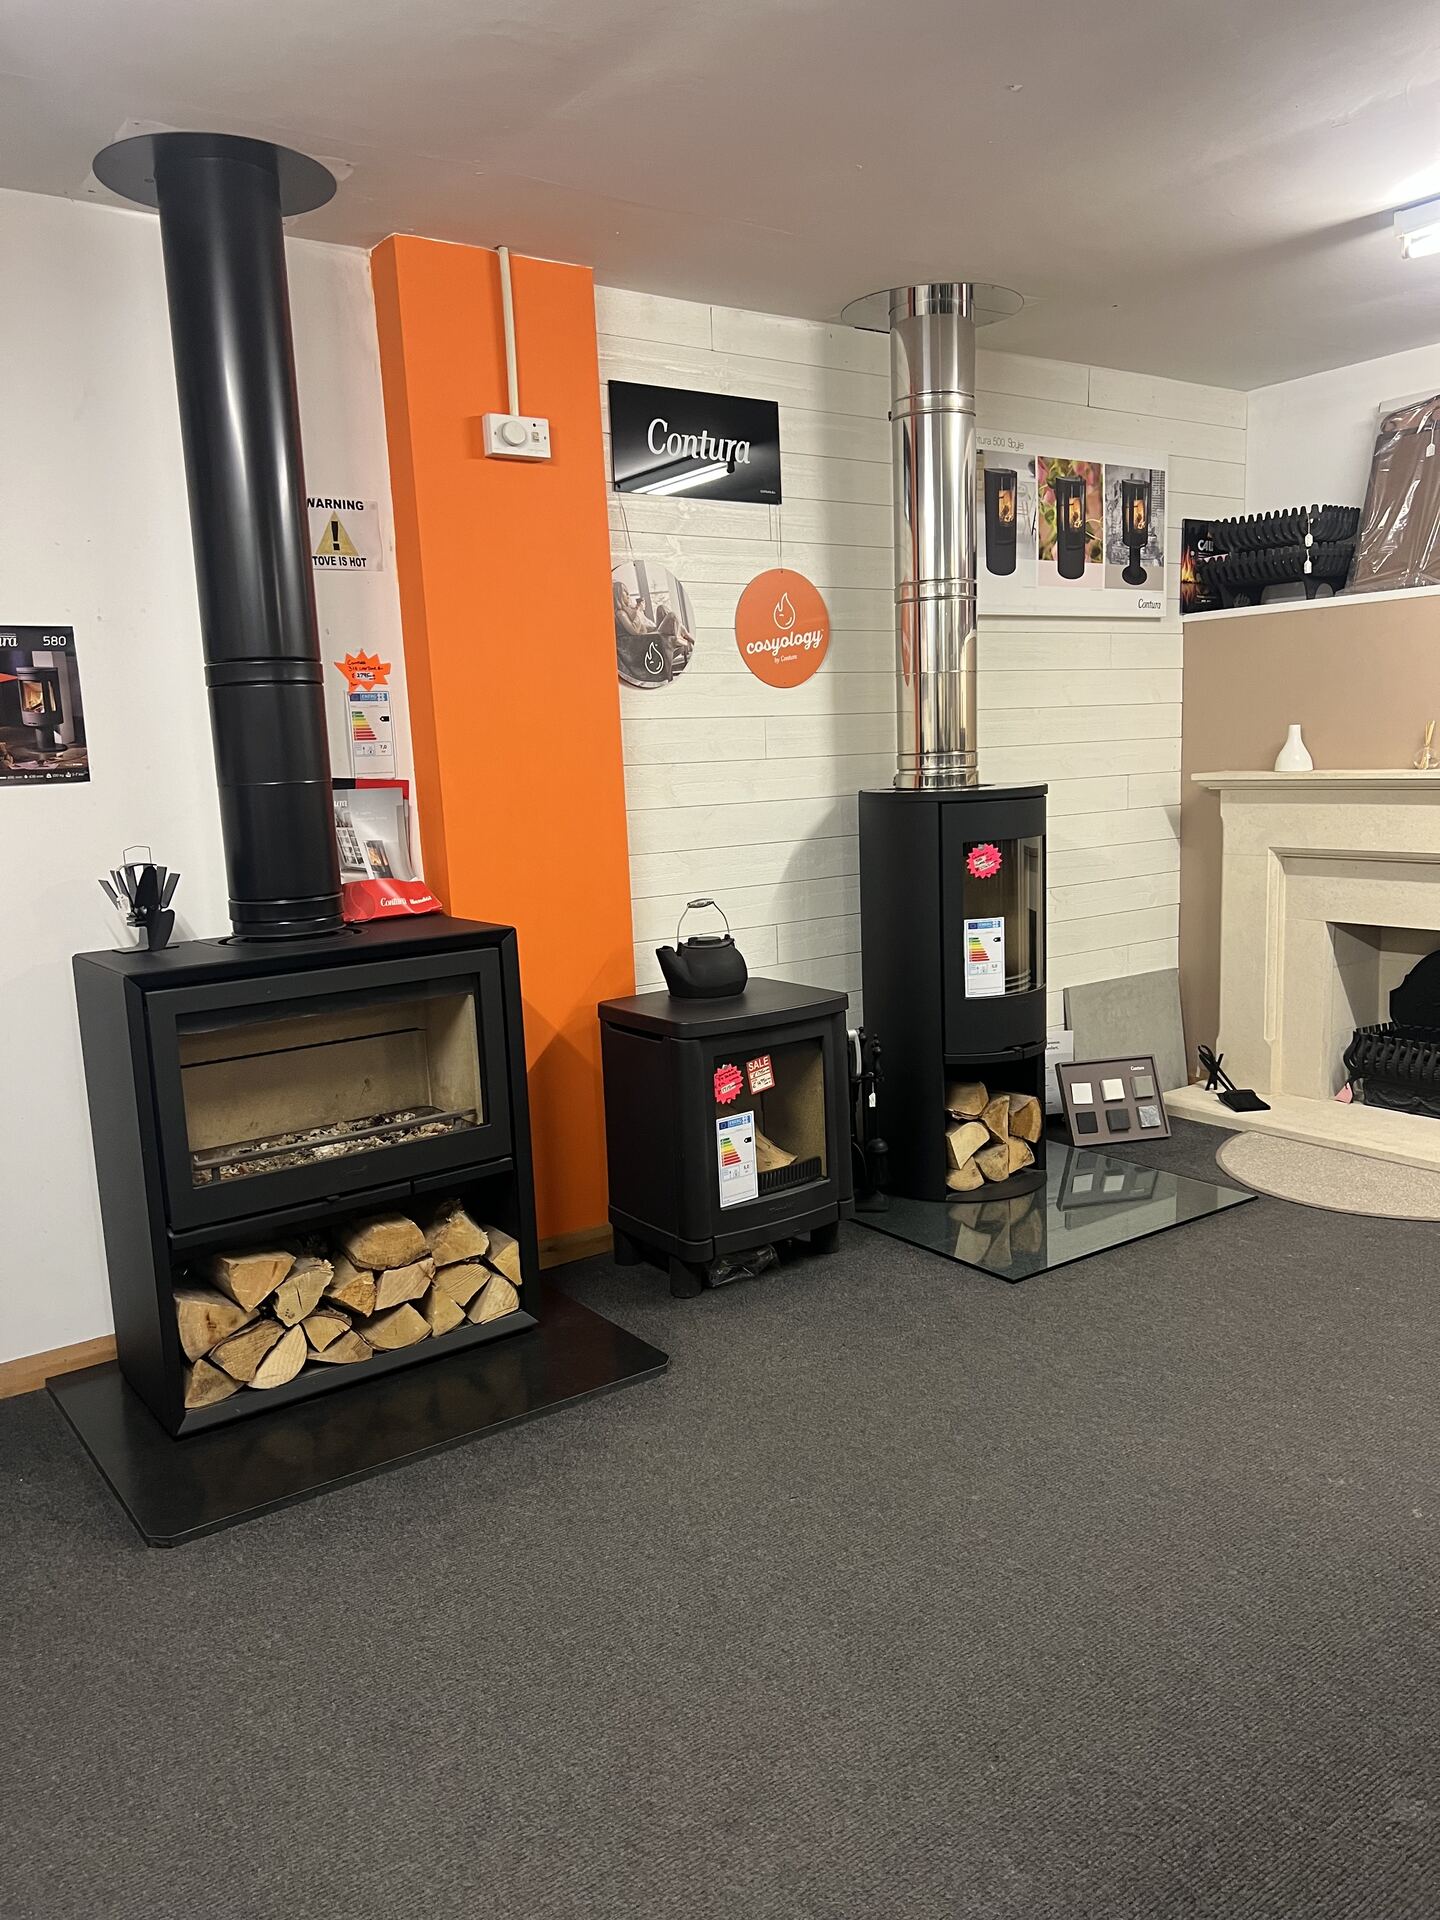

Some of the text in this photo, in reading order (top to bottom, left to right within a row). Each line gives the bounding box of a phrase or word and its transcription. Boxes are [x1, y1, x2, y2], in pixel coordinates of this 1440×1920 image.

[647, 418, 751, 464] Contura
[312, 555, 367, 568] TOVE IS HOT
[1137, 598, 1161, 610] Contura
[42, 635, 67, 647] 580
[746, 629, 824, 657] cosyology
[748, 1056, 769, 1072] SALE
